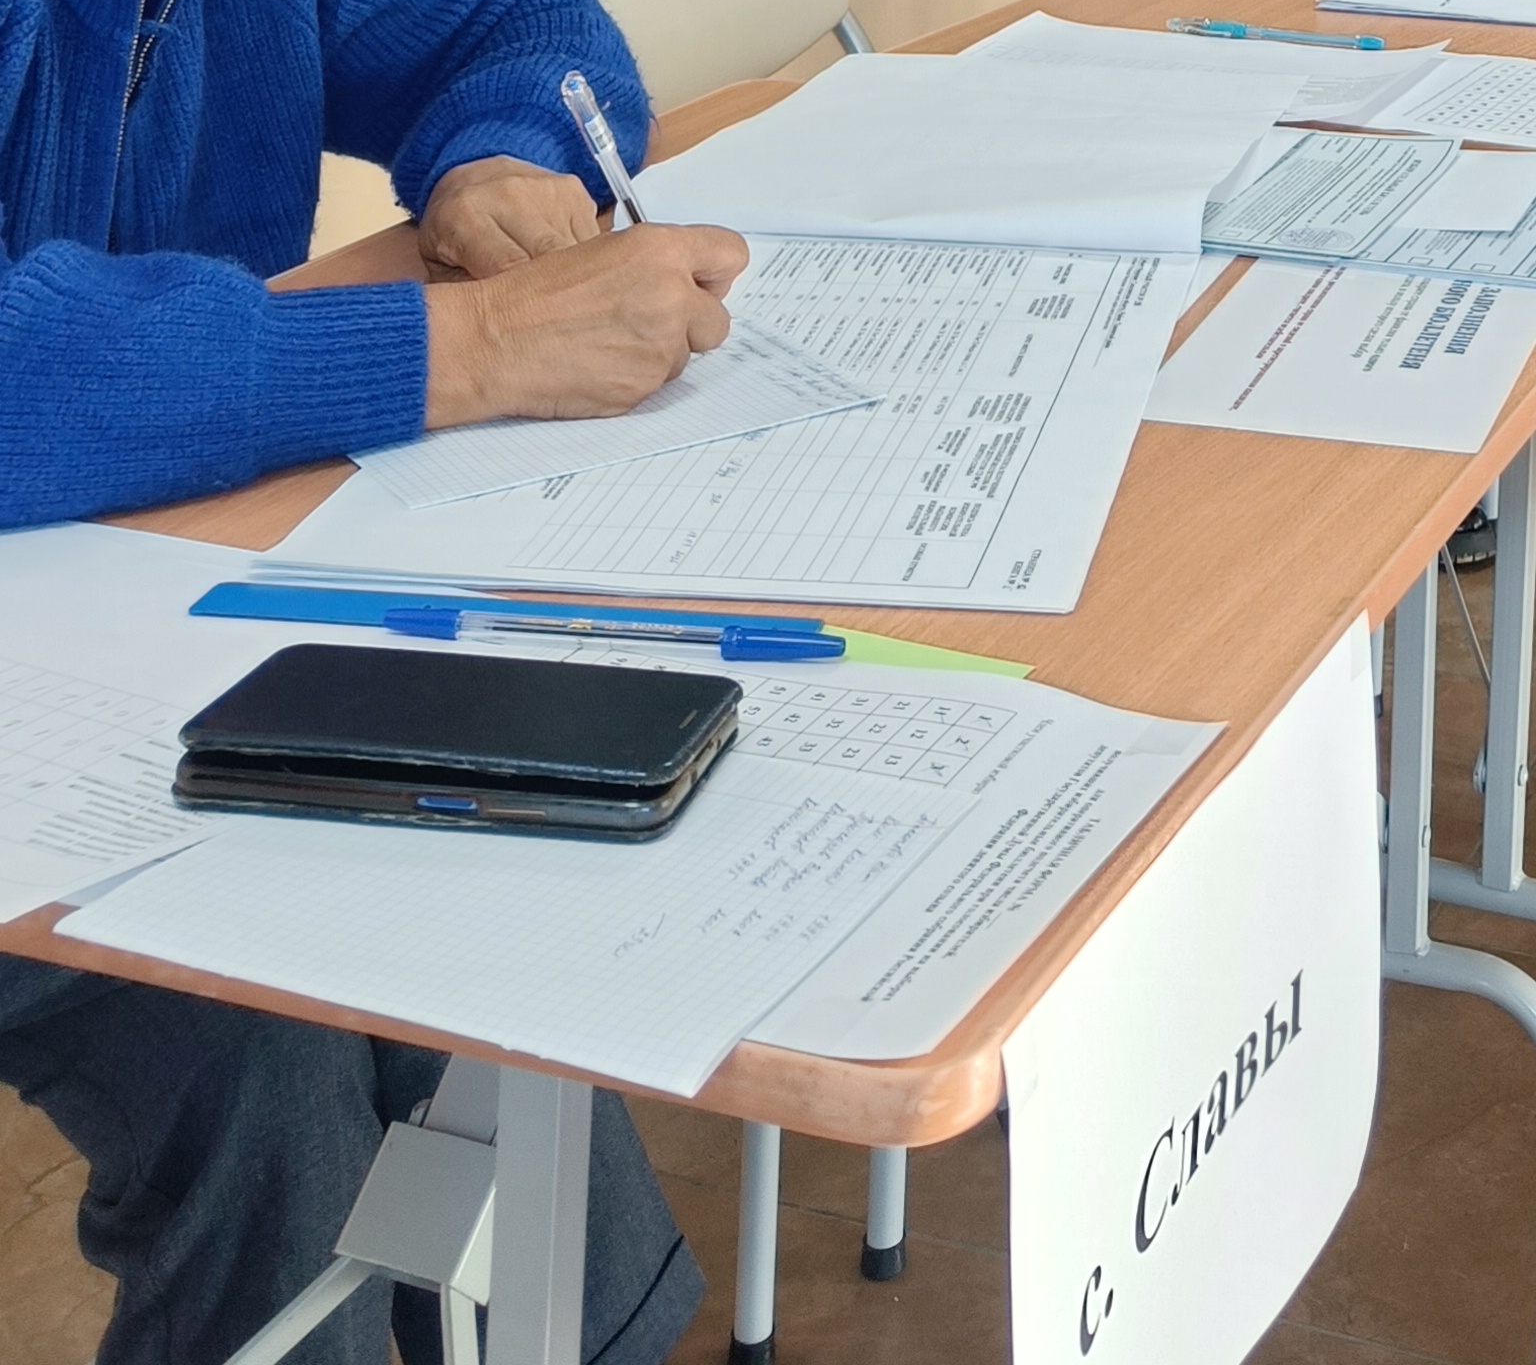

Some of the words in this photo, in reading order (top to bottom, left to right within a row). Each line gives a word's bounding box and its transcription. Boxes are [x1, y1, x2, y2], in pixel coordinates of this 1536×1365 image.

[1440, 279, 1474, 305] НОГО
[1443, 286, 1502, 355] ЗАПОЛНЕНИЯ
[1398, 306, 1456, 370] БЮЛЛЕТЕНЯ
[768, 686, 787, 695] 51
[810, 692, 826, 702] 41
[850, 697, 870, 707] 31
[742, 706, 761, 716] 52
[893, 701, 911, 711] 21
[934, 706, 951, 716] 11
[783, 713, 801, 723] 42
[825, 718, 845, 729] 32
[867, 723, 887, 734] 22
[756, 736, 773, 747] 43
[909, 729, 928, 740] 12
[798, 742, 818, 753] 33
[841, 747, 861, 759] 23
[884, 754, 902, 766] 13
[1017, 774, 1080, 837] Государственной
[984, 808, 1029, 850] Федерации
[1045, 802, 1093, 851] оперативного
[996, 836, 1023, 860] Думы
[1048, 818, 1101, 869] ТАБЛИЧНАЯ
[991, 846, 1036, 887] бюллетени
[1013, 851, 1049, 884] подсчета
[945, 861, 1002, 915] Федерального
[976, 888, 995, 903] при
[991, 885, 1017, 908] числа
[1017, 869, 1053, 901] ФОРМА
[908, 916, 948, 953] собрания
[929, 904, 980, 953] голосовании
[917, 954, 931, 965] на
[860, 954, 914, 1003] Российской
[882, 966, 921, 1002] выборах
[1080, 1264, 1115, 1357] с.
[1134, 968, 1305, 1256] Славы
